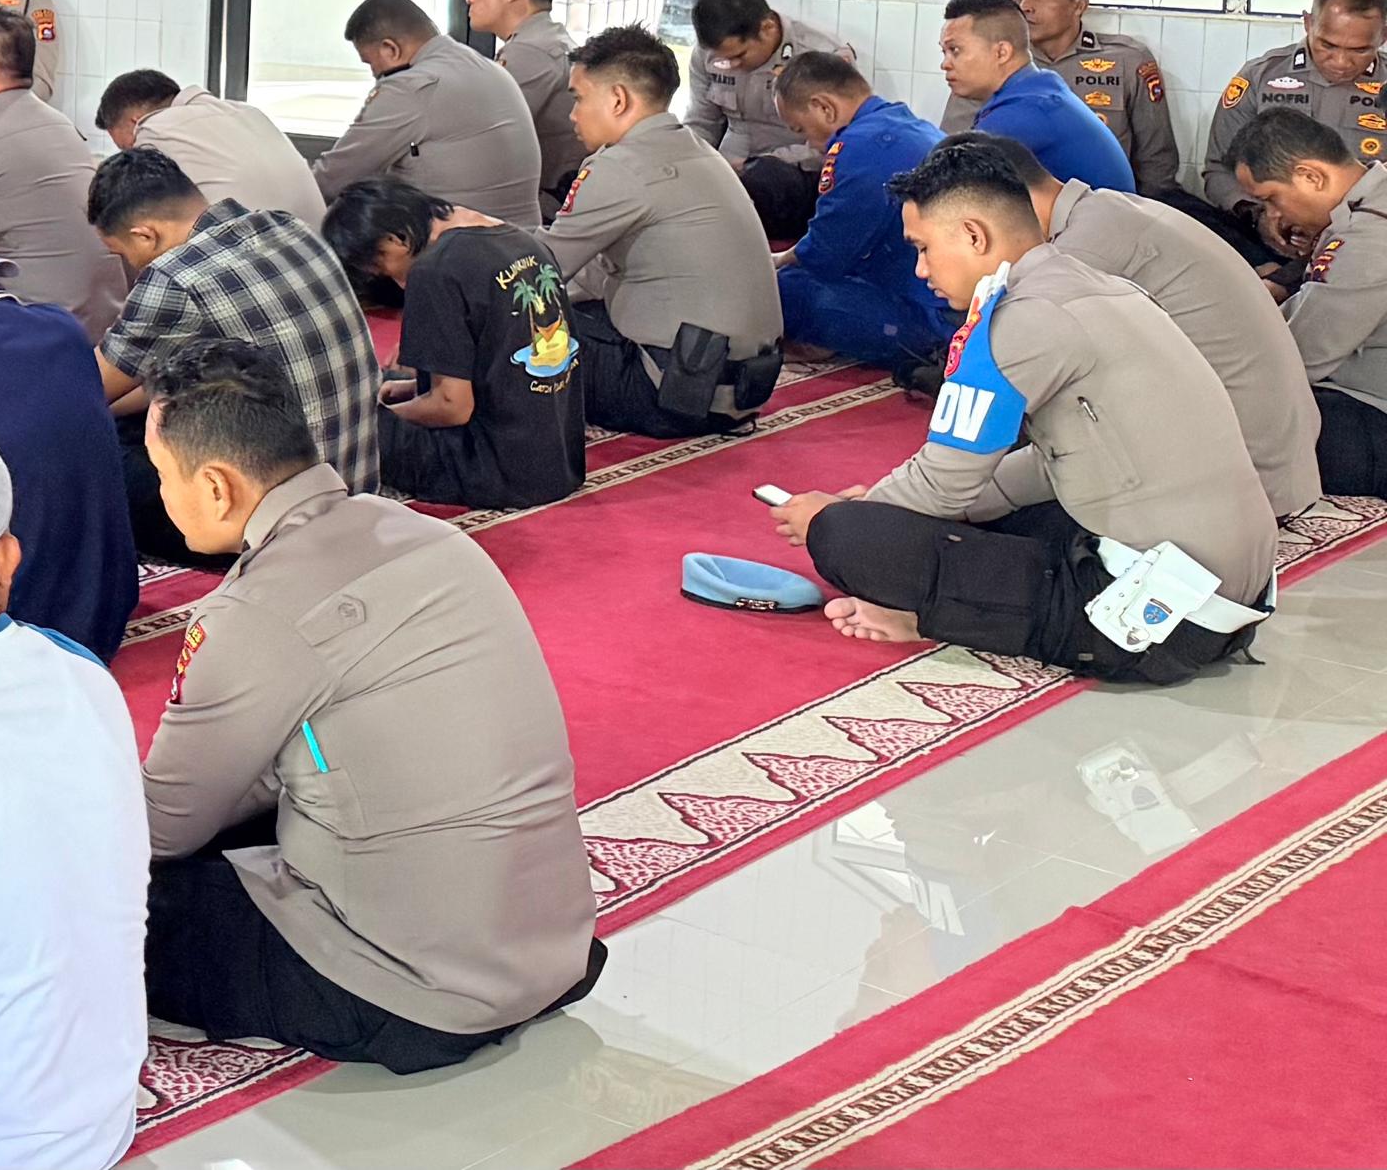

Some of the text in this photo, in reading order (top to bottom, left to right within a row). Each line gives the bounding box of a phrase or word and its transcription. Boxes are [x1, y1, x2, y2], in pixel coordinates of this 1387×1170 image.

[1075, 76, 1120, 86] POLRI
[1261, 92, 1309, 105] NOFRI
[1349, 95, 1382, 108] POL
